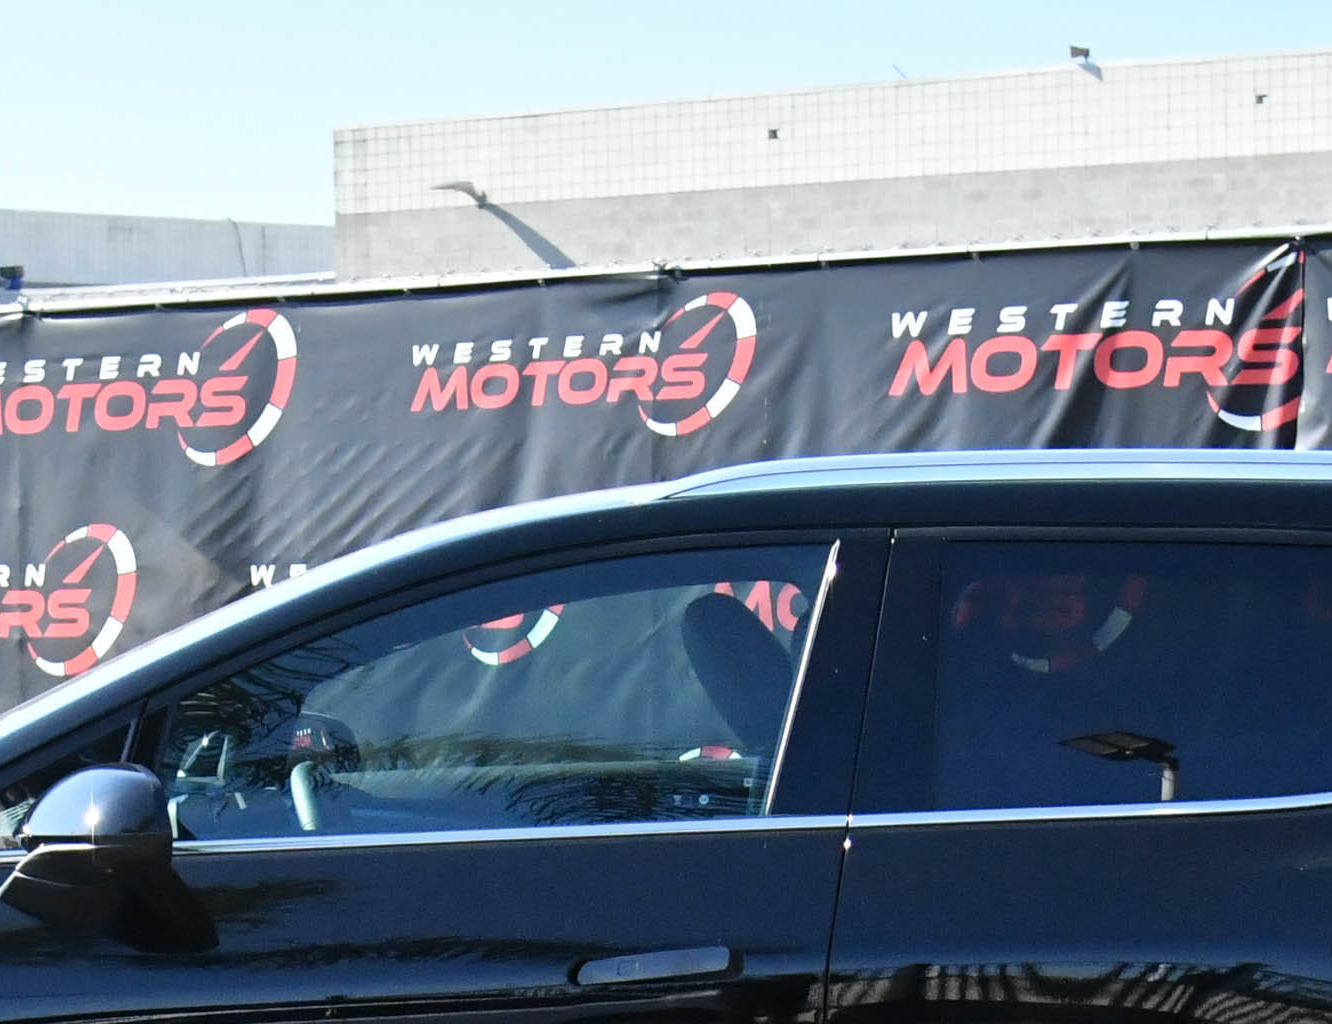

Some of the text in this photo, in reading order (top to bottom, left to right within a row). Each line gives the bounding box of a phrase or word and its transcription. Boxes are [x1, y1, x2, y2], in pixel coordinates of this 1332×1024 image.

[892, 298, 1234, 342] WESTERN
[413, 332, 661, 366] WESTERN
[890, 327, 1300, 395] MOTORS
[411, 353, 707, 411] MOTORS
